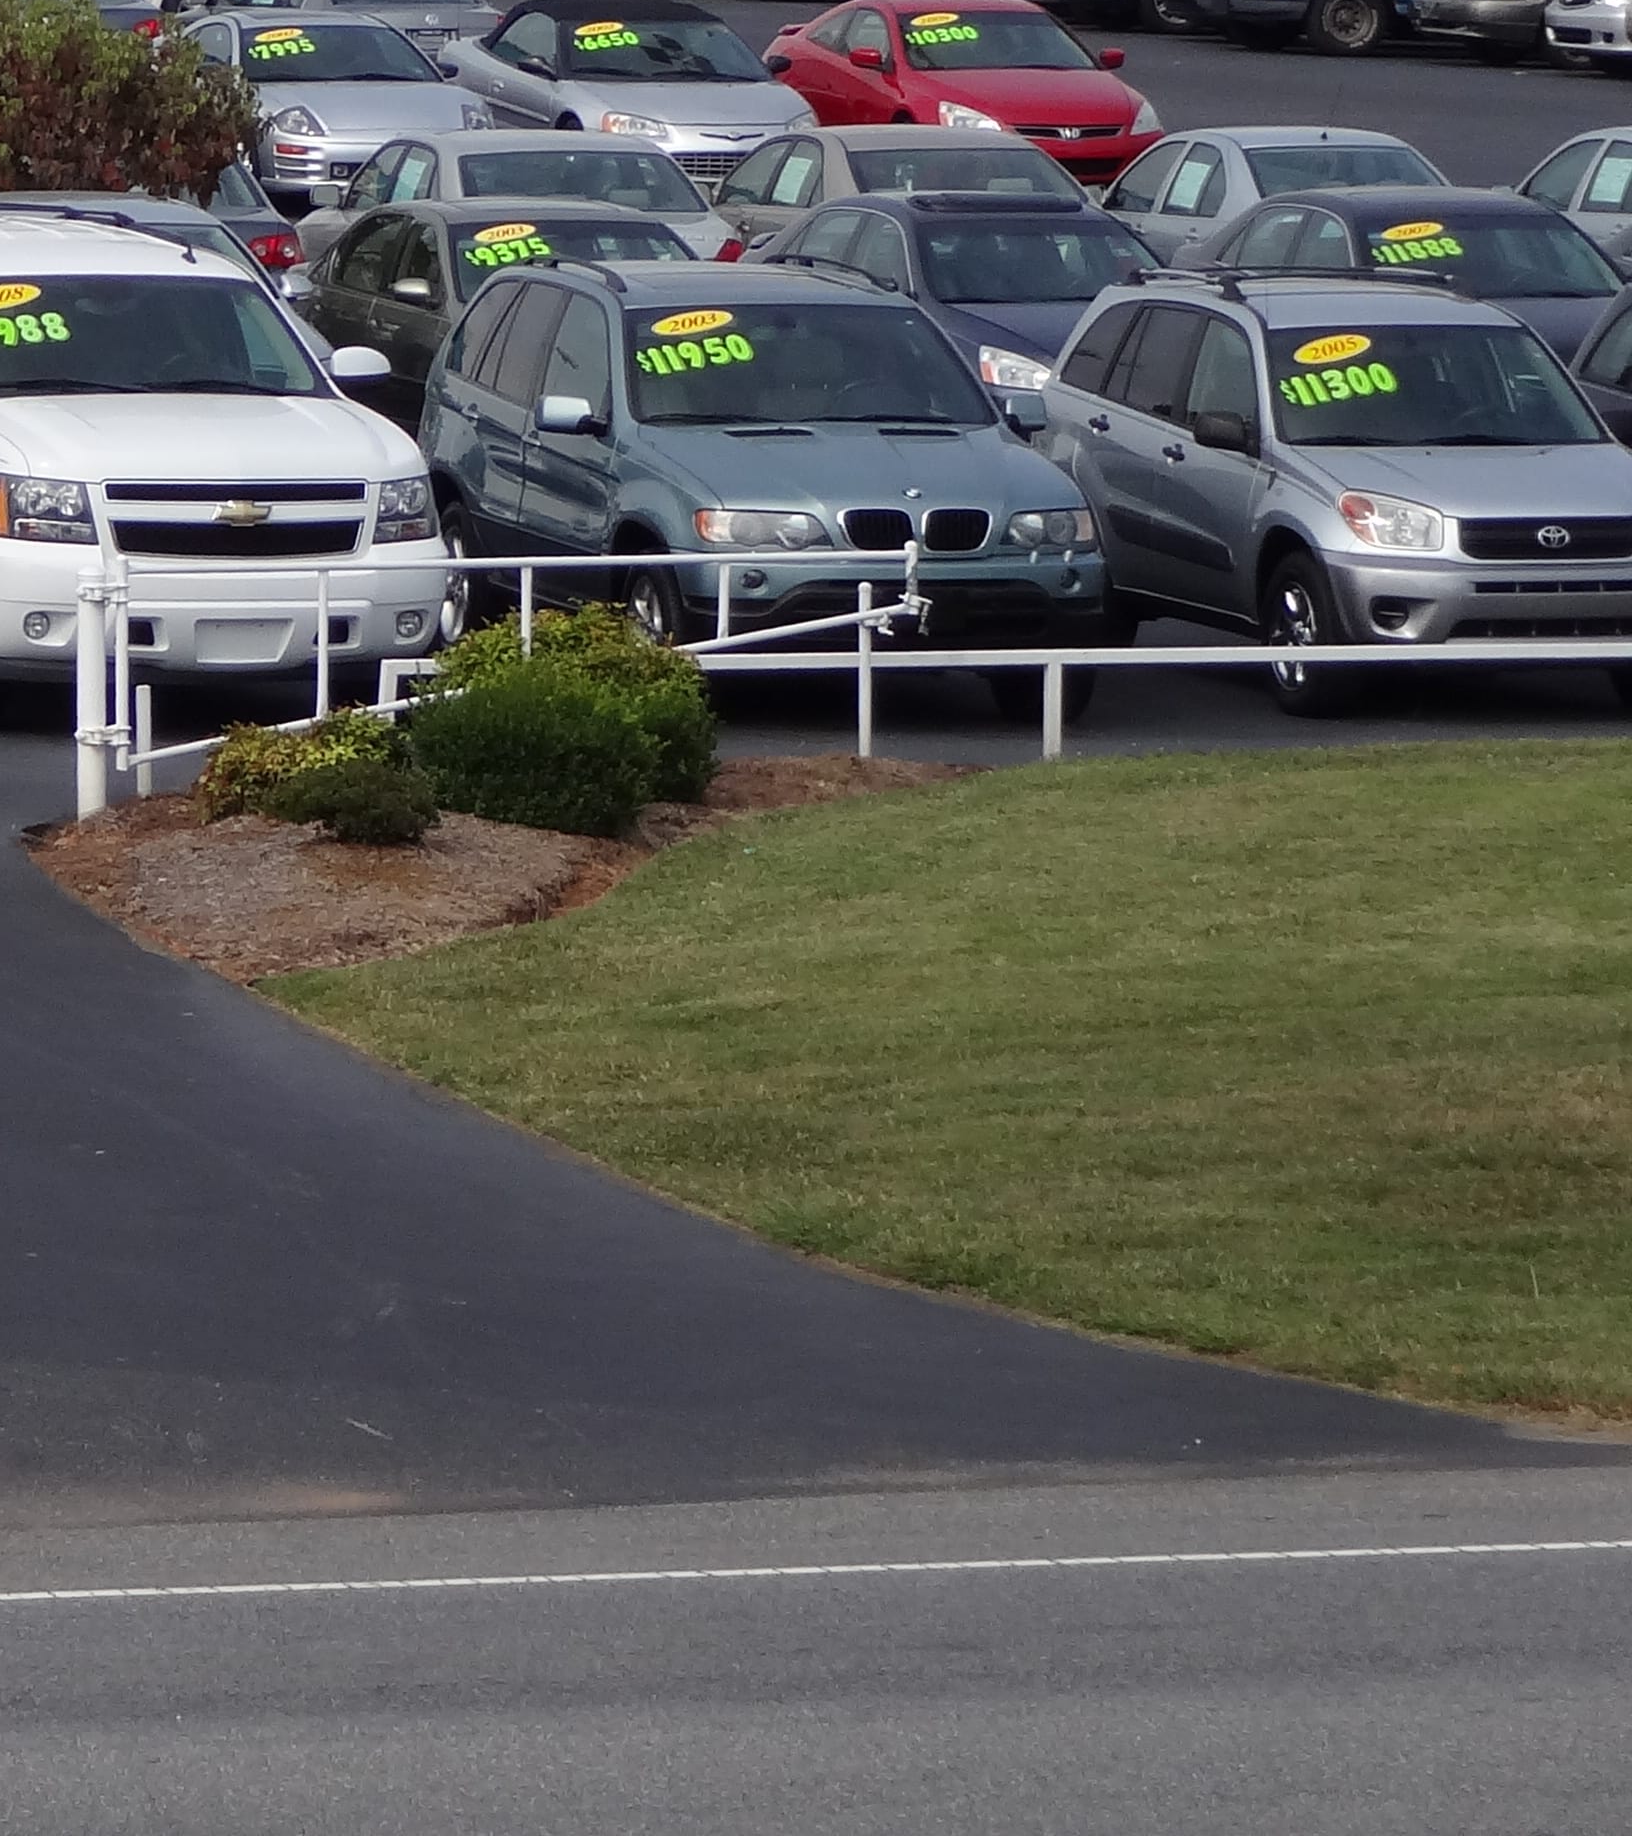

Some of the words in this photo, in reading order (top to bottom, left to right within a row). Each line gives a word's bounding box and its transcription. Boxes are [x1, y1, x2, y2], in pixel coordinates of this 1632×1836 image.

[574, 31, 640, 50] $6650
[905, 26, 979, 45] $10300
[248, 39, 316, 59] $7995
[464, 236, 552, 266] $9375
[1371, 237, 1463, 263] $11888
[670, 313, 716, 332] 2003
[636, 334, 755, 375] $11950
[1311, 337, 1356, 360] 2005
[1280, 362, 1398, 407] $11300
